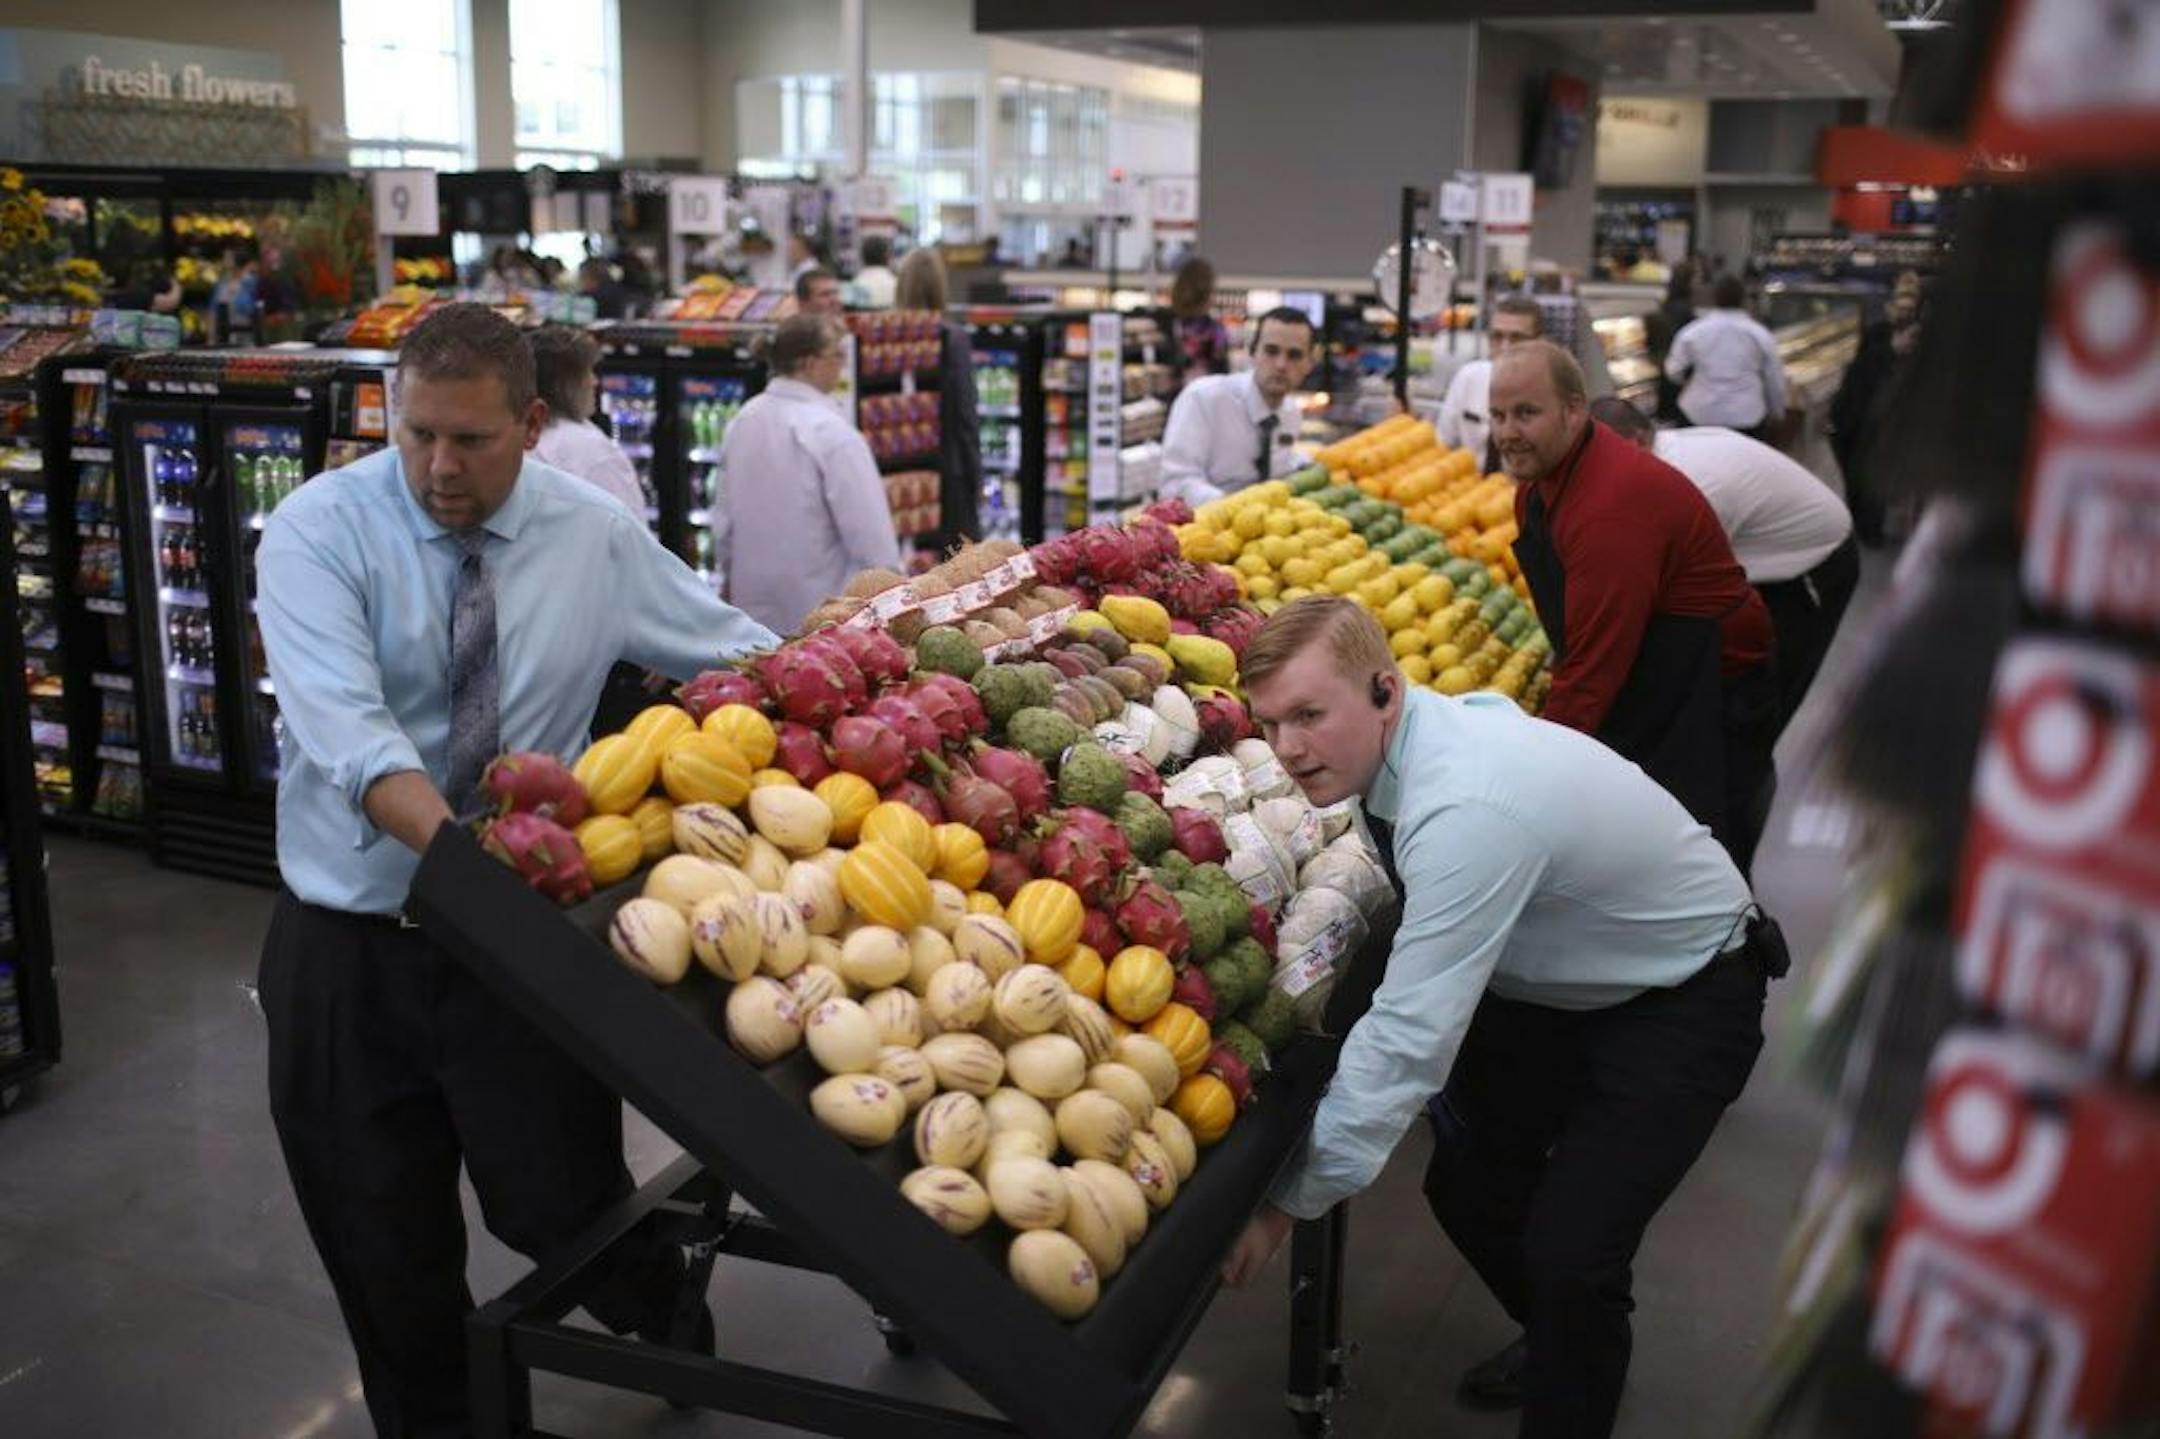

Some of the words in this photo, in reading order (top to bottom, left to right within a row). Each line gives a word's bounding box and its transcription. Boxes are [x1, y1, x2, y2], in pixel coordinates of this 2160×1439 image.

[84, 55, 171, 99] fresh
[183, 63, 296, 108] flowers
[391, 185, 411, 221] 9
[681, 192, 708, 221] 10
[1496, 187, 1520, 213] 11
